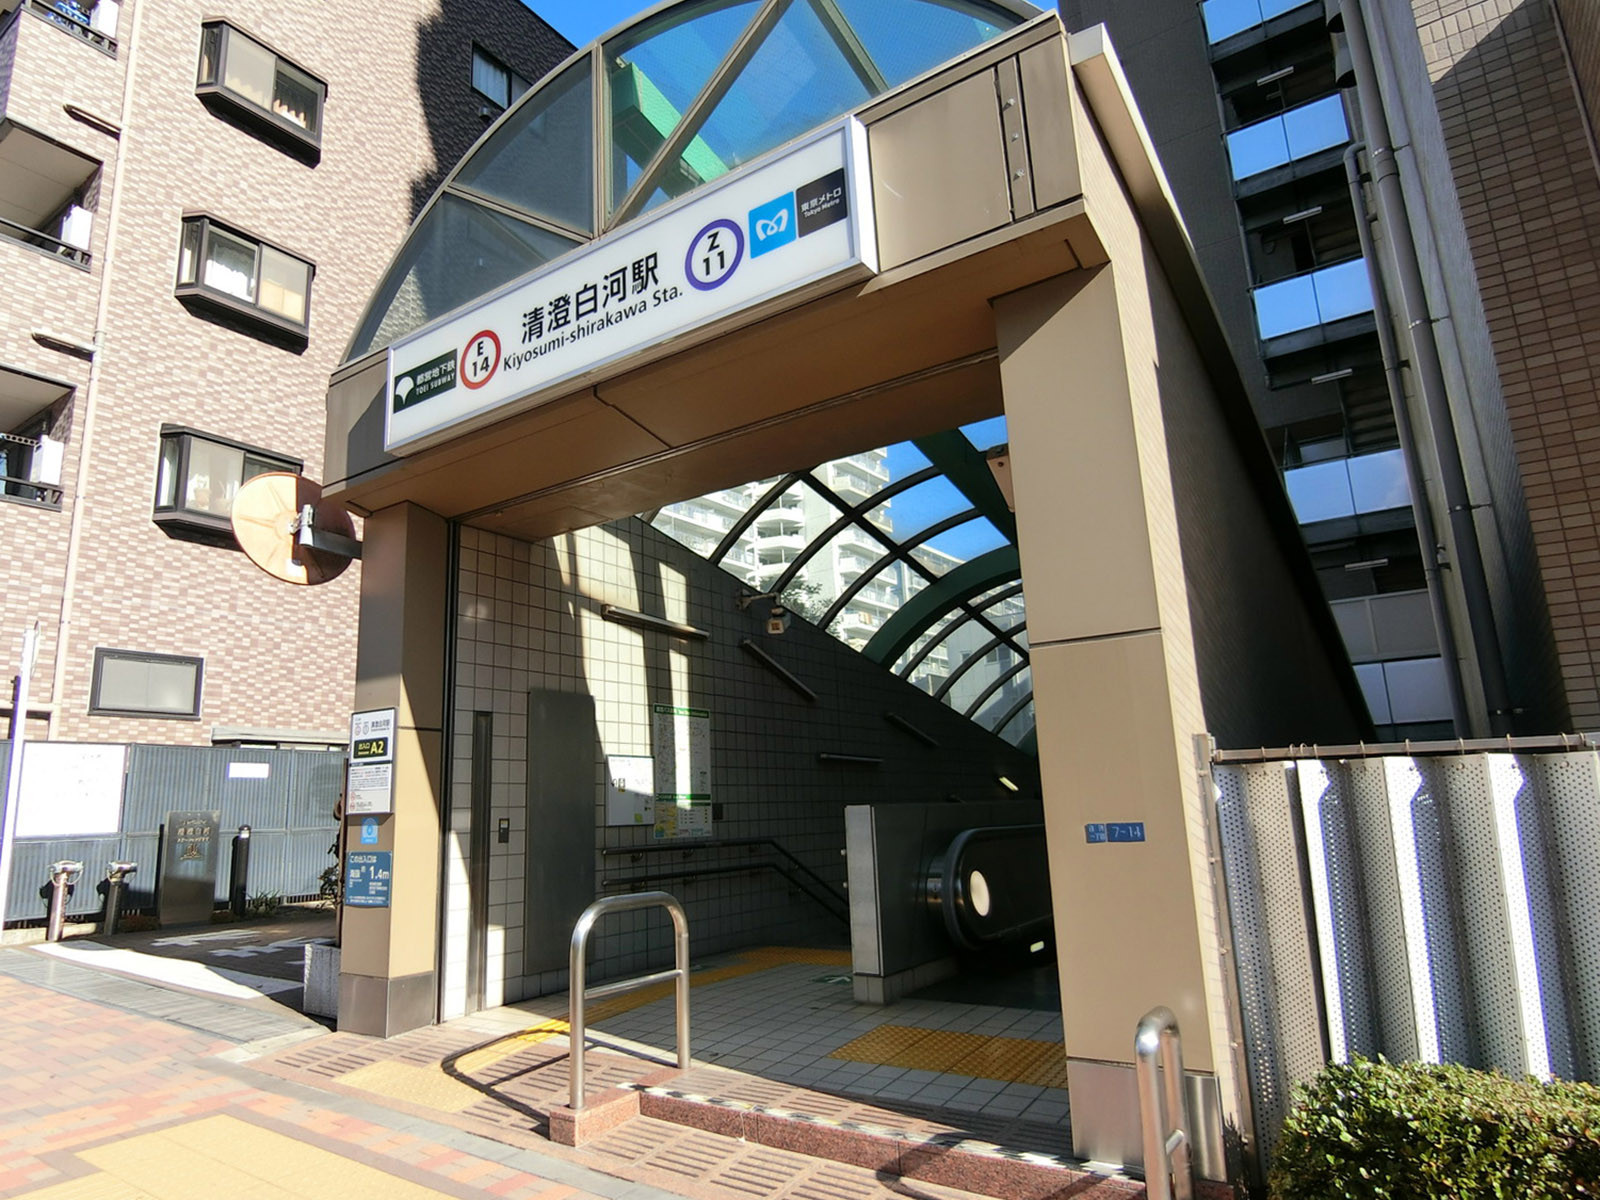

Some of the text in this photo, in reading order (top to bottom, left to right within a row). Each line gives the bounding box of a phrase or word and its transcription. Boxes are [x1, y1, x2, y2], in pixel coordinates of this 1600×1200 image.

[800, 187, 842, 213] 東京メトロ
[803, 198, 840, 218] Tokyo Metro
[707, 230, 720, 253] Z
[702, 250, 725, 276] 11
[521, 251, 659, 345] 清澄白河駅
[503, 286, 683, 371] Kiyosumi-shirakawa Sta.
[476, 341, 484, 357] E
[416, 360, 456, 386] 都営地下鉄
[472, 356, 490, 377] 14
[416, 372, 455, 396] TOEI SUBWAY
[370, 740, 384, 754] A2
[369, 865, 390, 880] 1.4m
